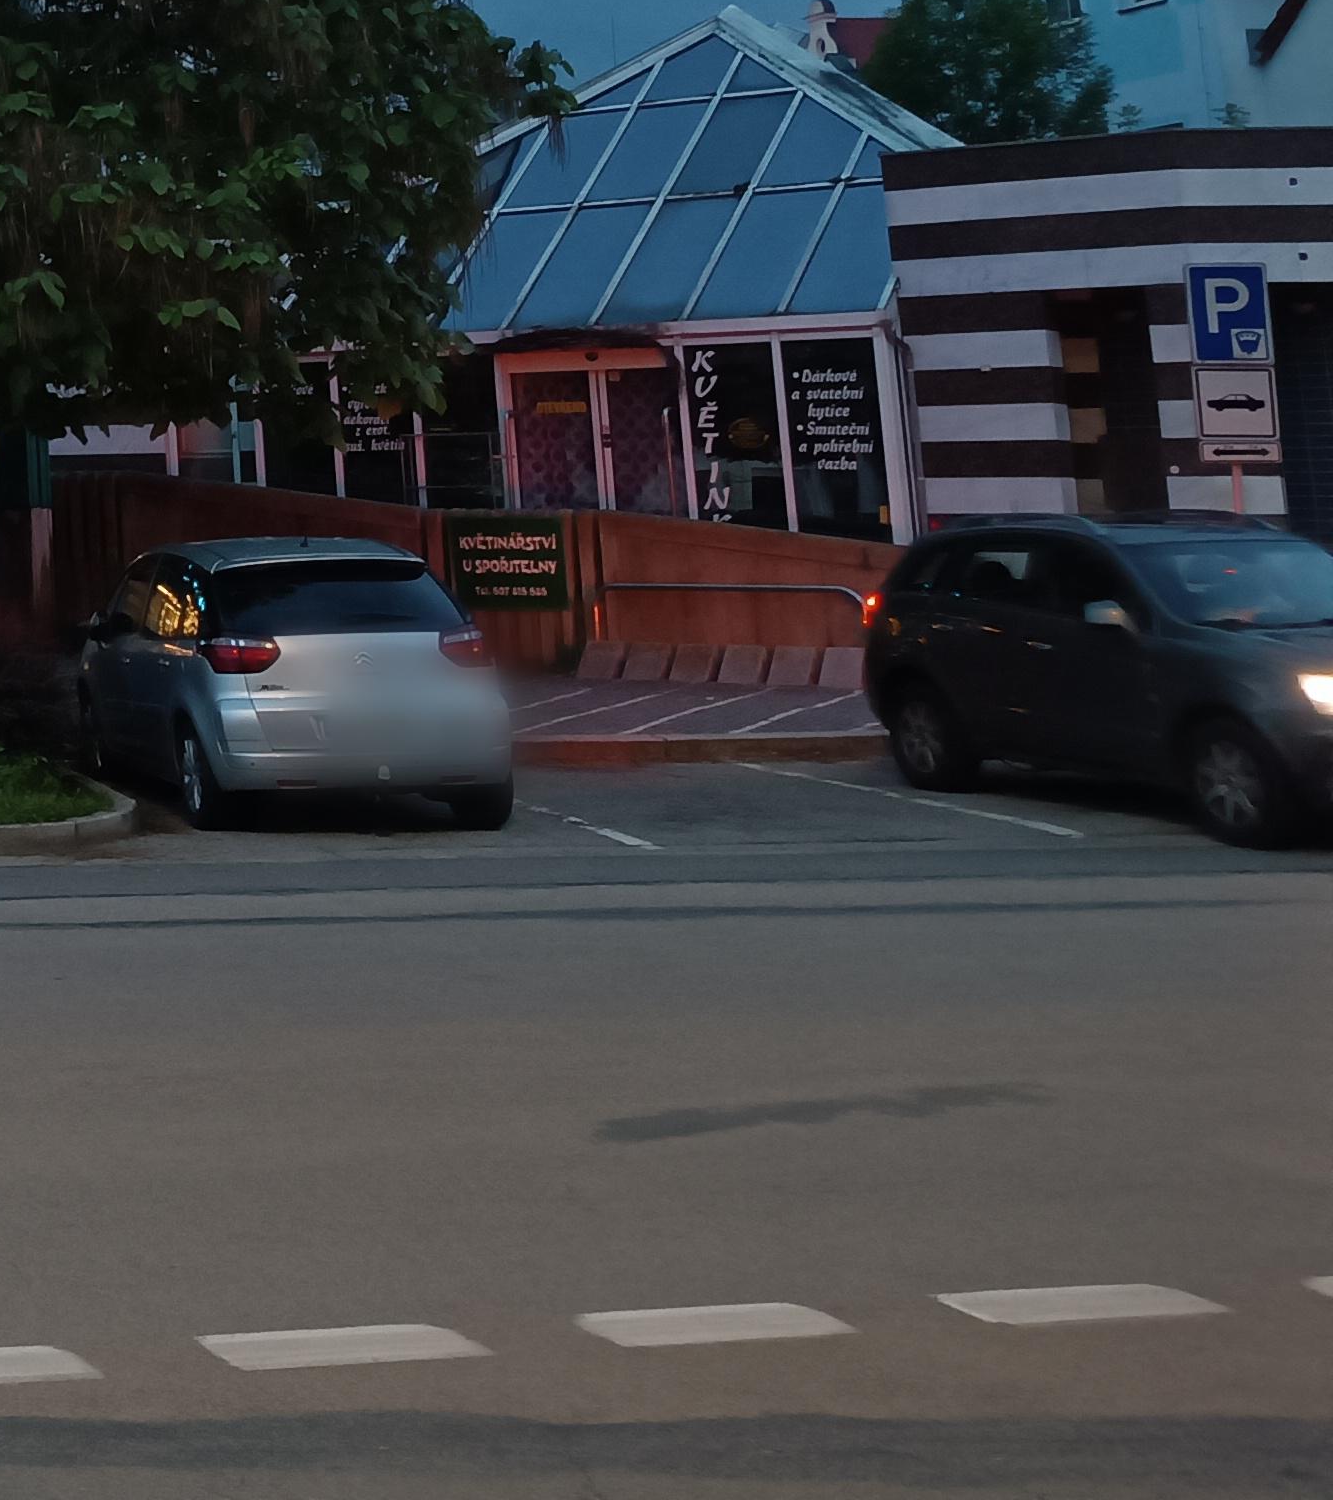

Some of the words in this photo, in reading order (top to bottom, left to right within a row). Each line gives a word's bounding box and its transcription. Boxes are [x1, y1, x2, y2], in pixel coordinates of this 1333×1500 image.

[1204, 277, 1250, 334] P
[801, 368, 858, 383] Dárkové
[791, 390, 800, 400] a
[805, 385, 864, 400] svatební
[807, 403, 851, 420] kytice
[806, 421, 870, 436] Smuteční
[798, 442, 808, 453] a
[813, 438, 874, 456] pohřební
[817, 456, 858, 470] vazba
[458, 531, 557, 551] KVĚTINÁŘSTVÍ
[462, 558, 472, 572] U
[475, 556, 557, 575] SPOŘITELNY
